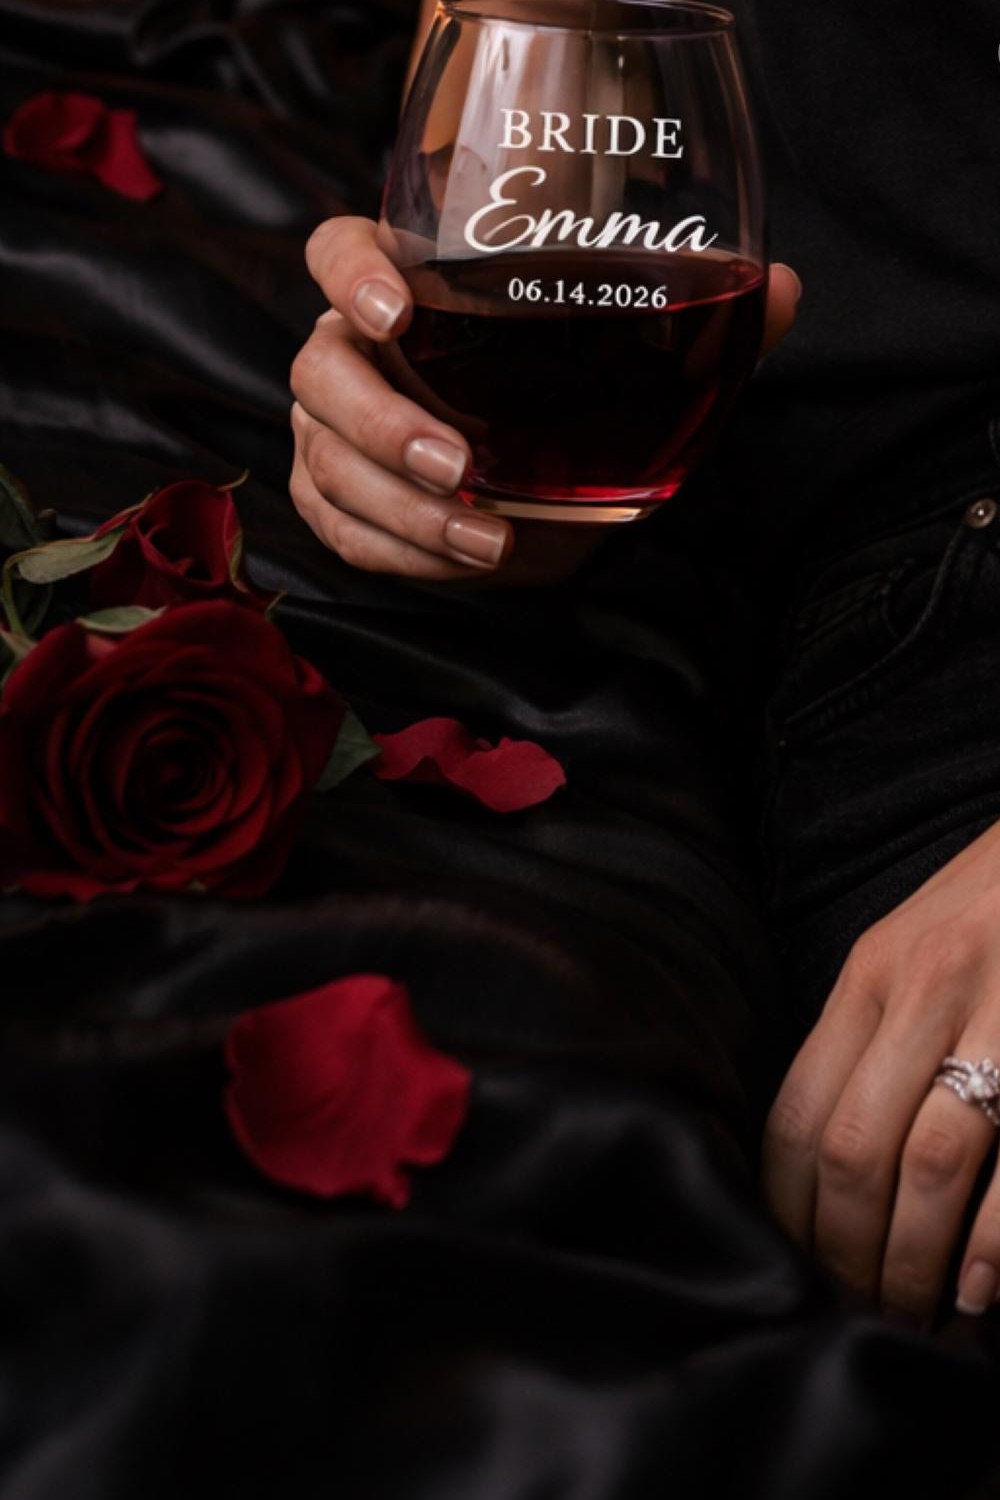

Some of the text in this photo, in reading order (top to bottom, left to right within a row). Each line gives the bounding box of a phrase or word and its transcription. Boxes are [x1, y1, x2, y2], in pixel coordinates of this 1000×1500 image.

[496, 106, 685, 160] BRIDE
[463, 164, 719, 253] Emma
[507, 276, 669, 309] 06.14.2026
